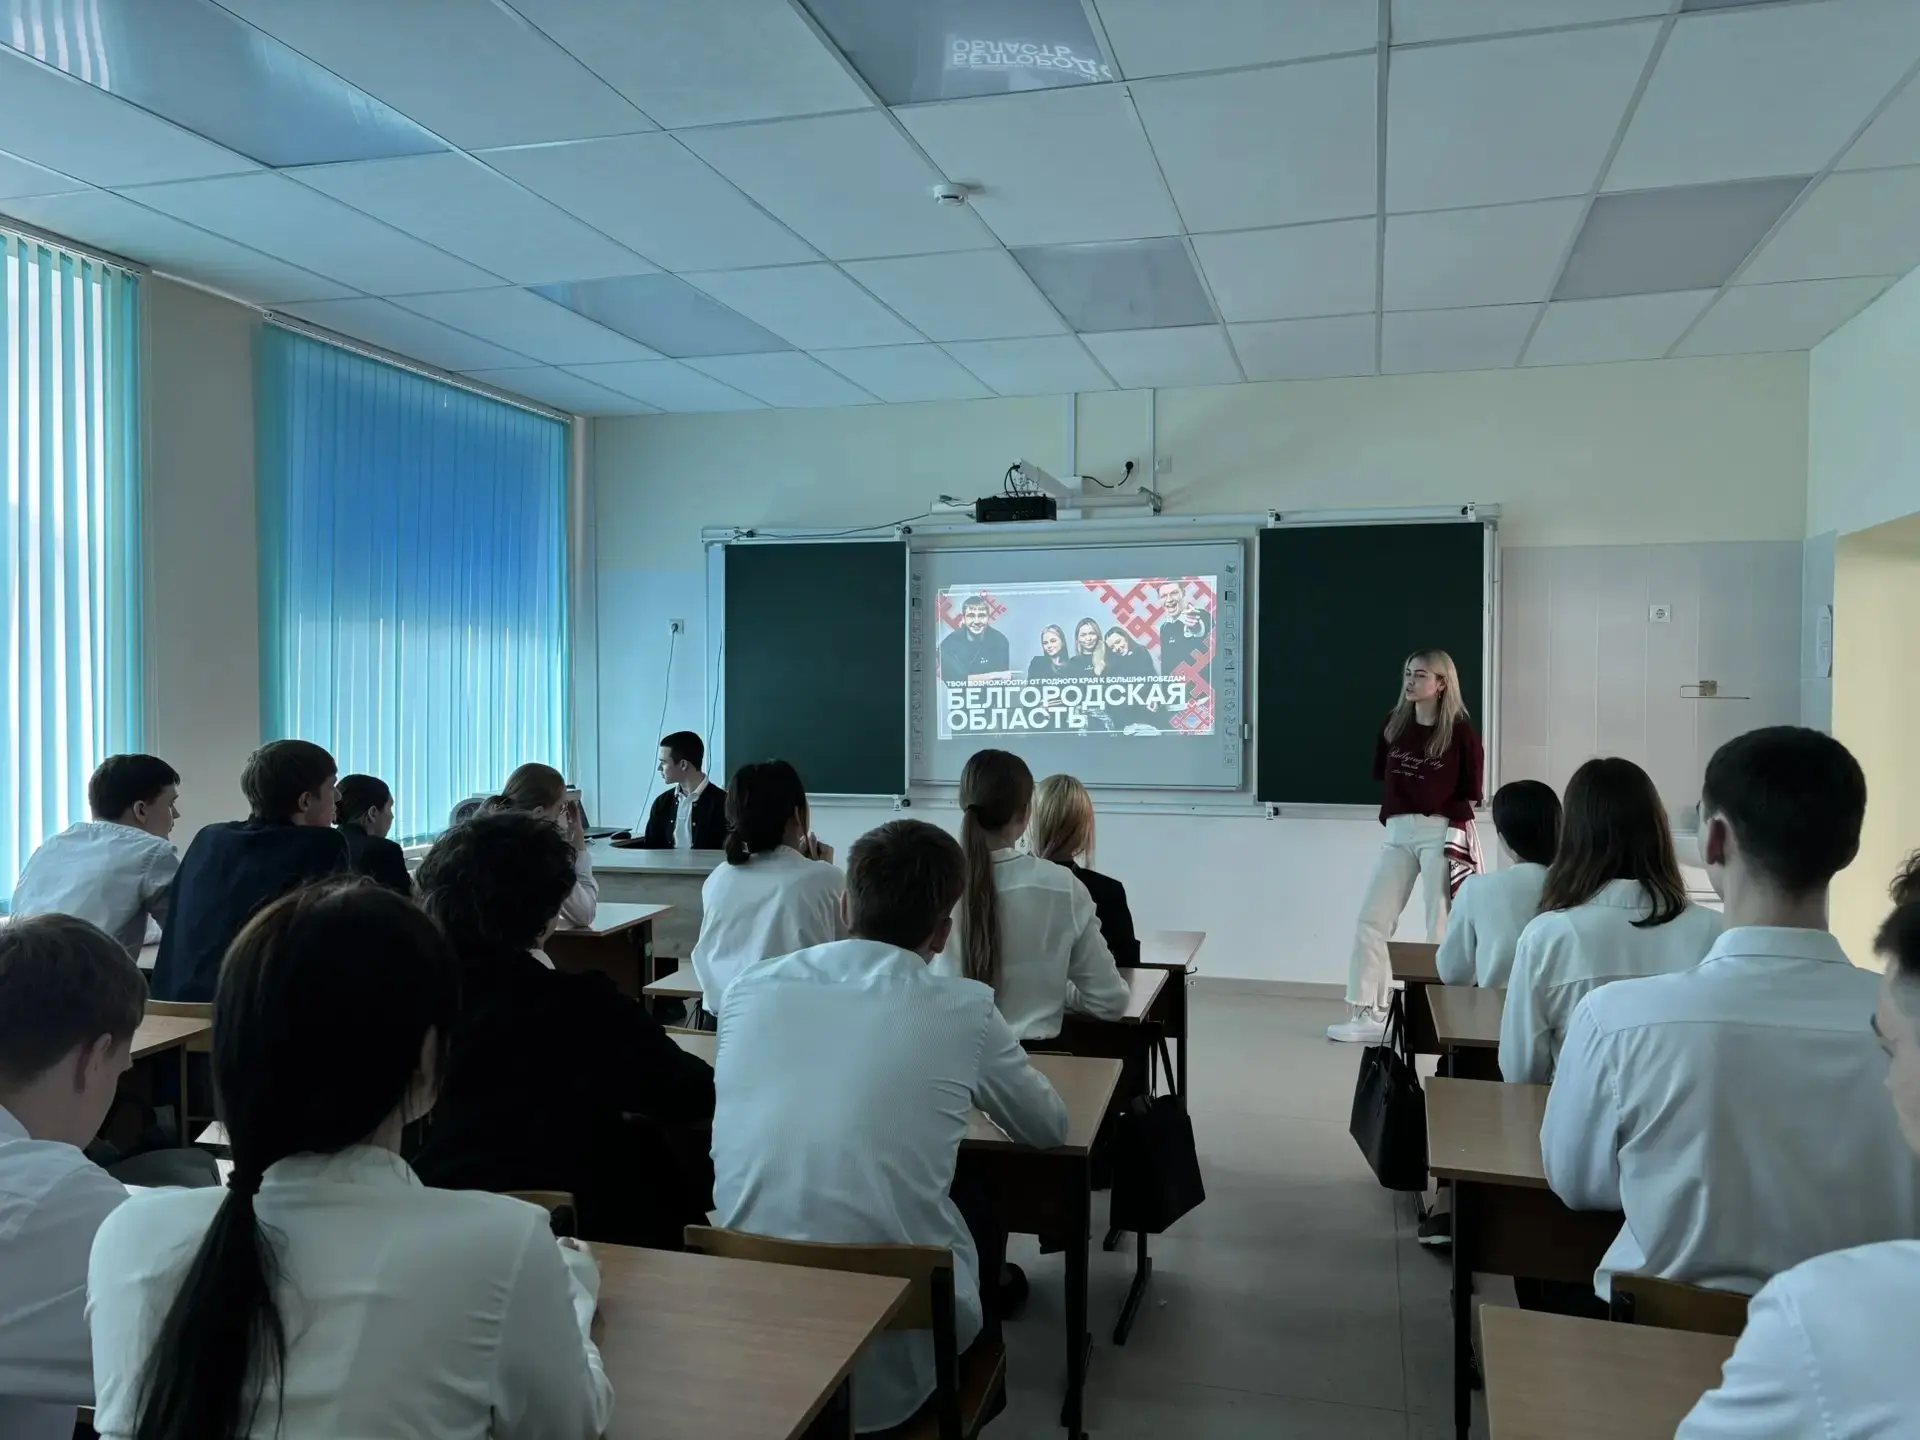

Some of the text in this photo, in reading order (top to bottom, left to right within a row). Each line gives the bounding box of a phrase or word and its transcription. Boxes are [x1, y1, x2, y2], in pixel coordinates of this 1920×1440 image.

[1030, 678, 1041, 686] ОТ
[1041, 677, 1078, 686] РОДНОГО
[1078, 677, 1098, 685] КРАЯ
[1106, 676, 1146, 684] БОЛЬШИМ
[1147, 675, 1186, 684] ПОБЕДАМ
[947, 683, 1186, 710] БЕЛГОРОДСКАЯ
[947, 707, 1087, 731] ОБЛАСТЬ
